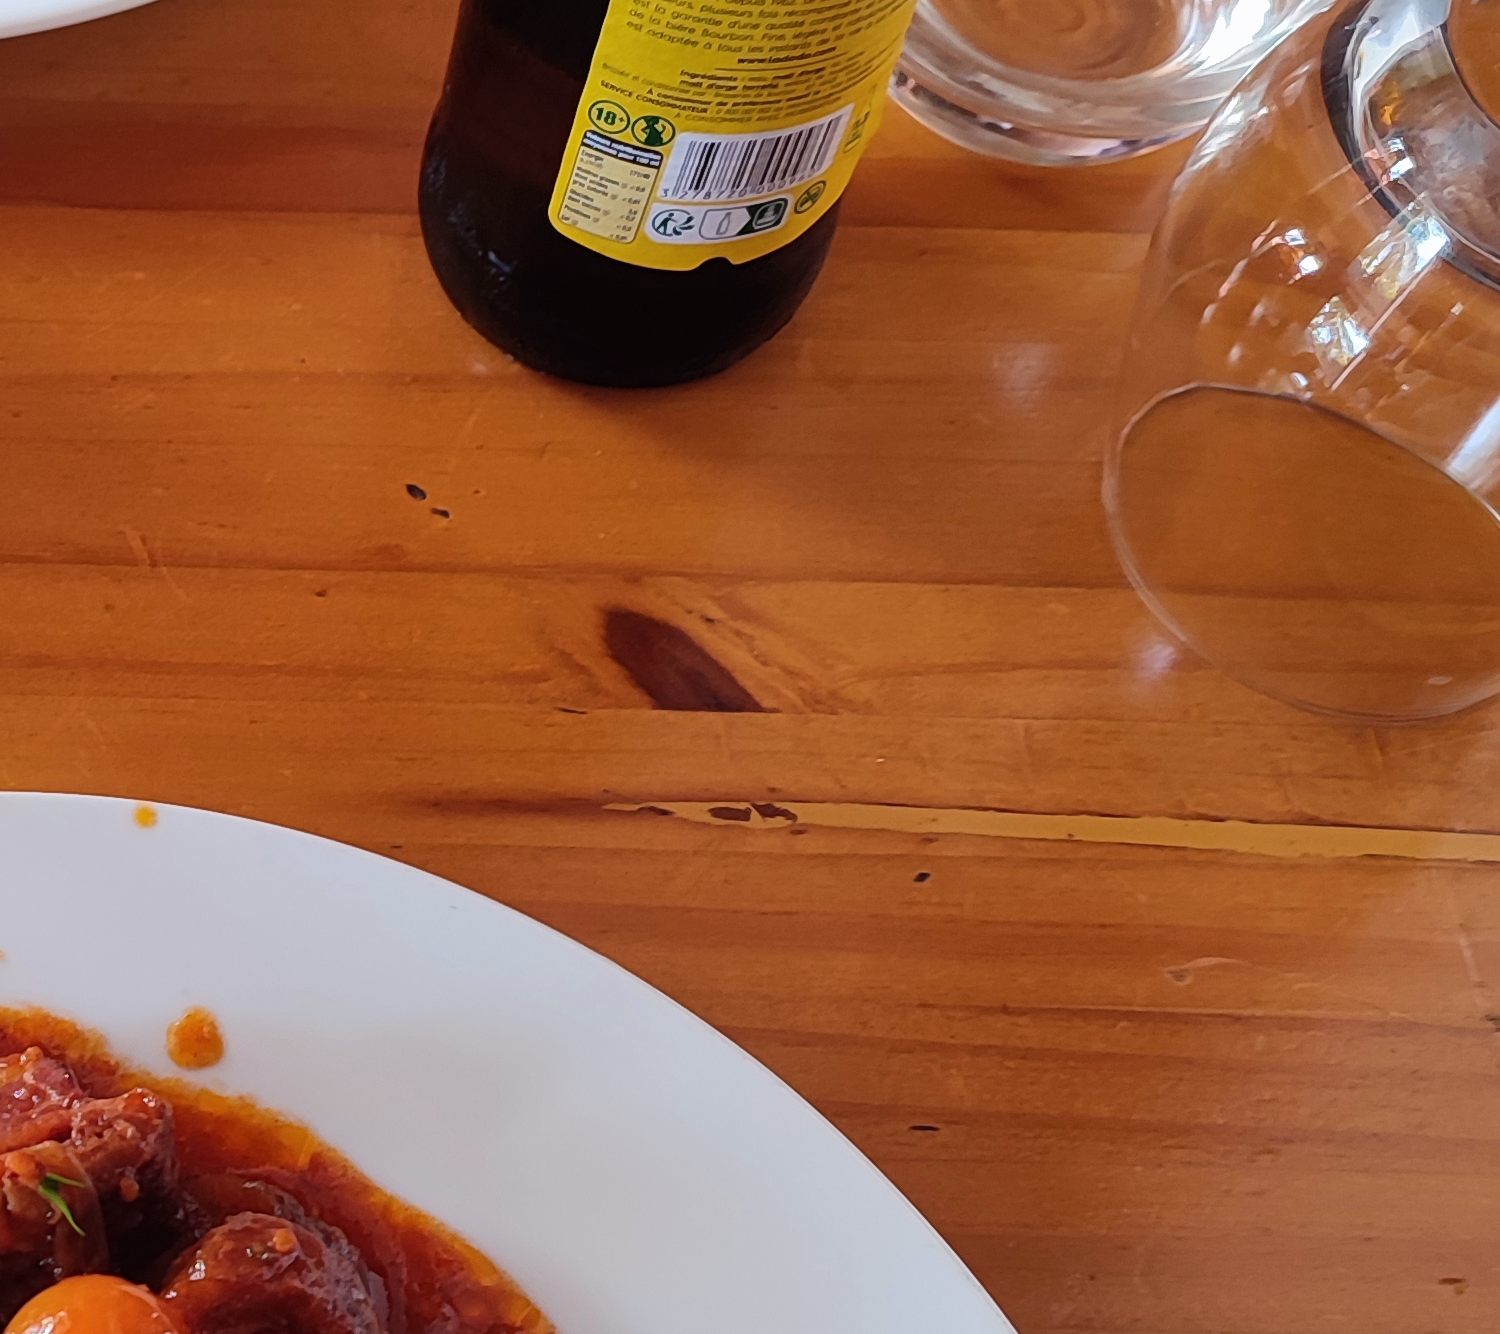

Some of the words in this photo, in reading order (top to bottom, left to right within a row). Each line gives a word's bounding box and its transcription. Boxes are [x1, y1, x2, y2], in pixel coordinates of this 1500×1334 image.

[628, 9, 645, 20] de
[649, 16, 660, 26] la
[665, 20, 696, 34] bière
[654, 4, 667, 15] la
[671, 11, 722, 27] garantie
[626, 20, 643, 33] est
[647, 29, 699, 48] adaptée
[717, 43, 743, 53] tous
[737, 46, 838, 65] www.ladodo.com
[600, 79, 634, 100] SERVICE
[660, 188, 669, 198] 3
